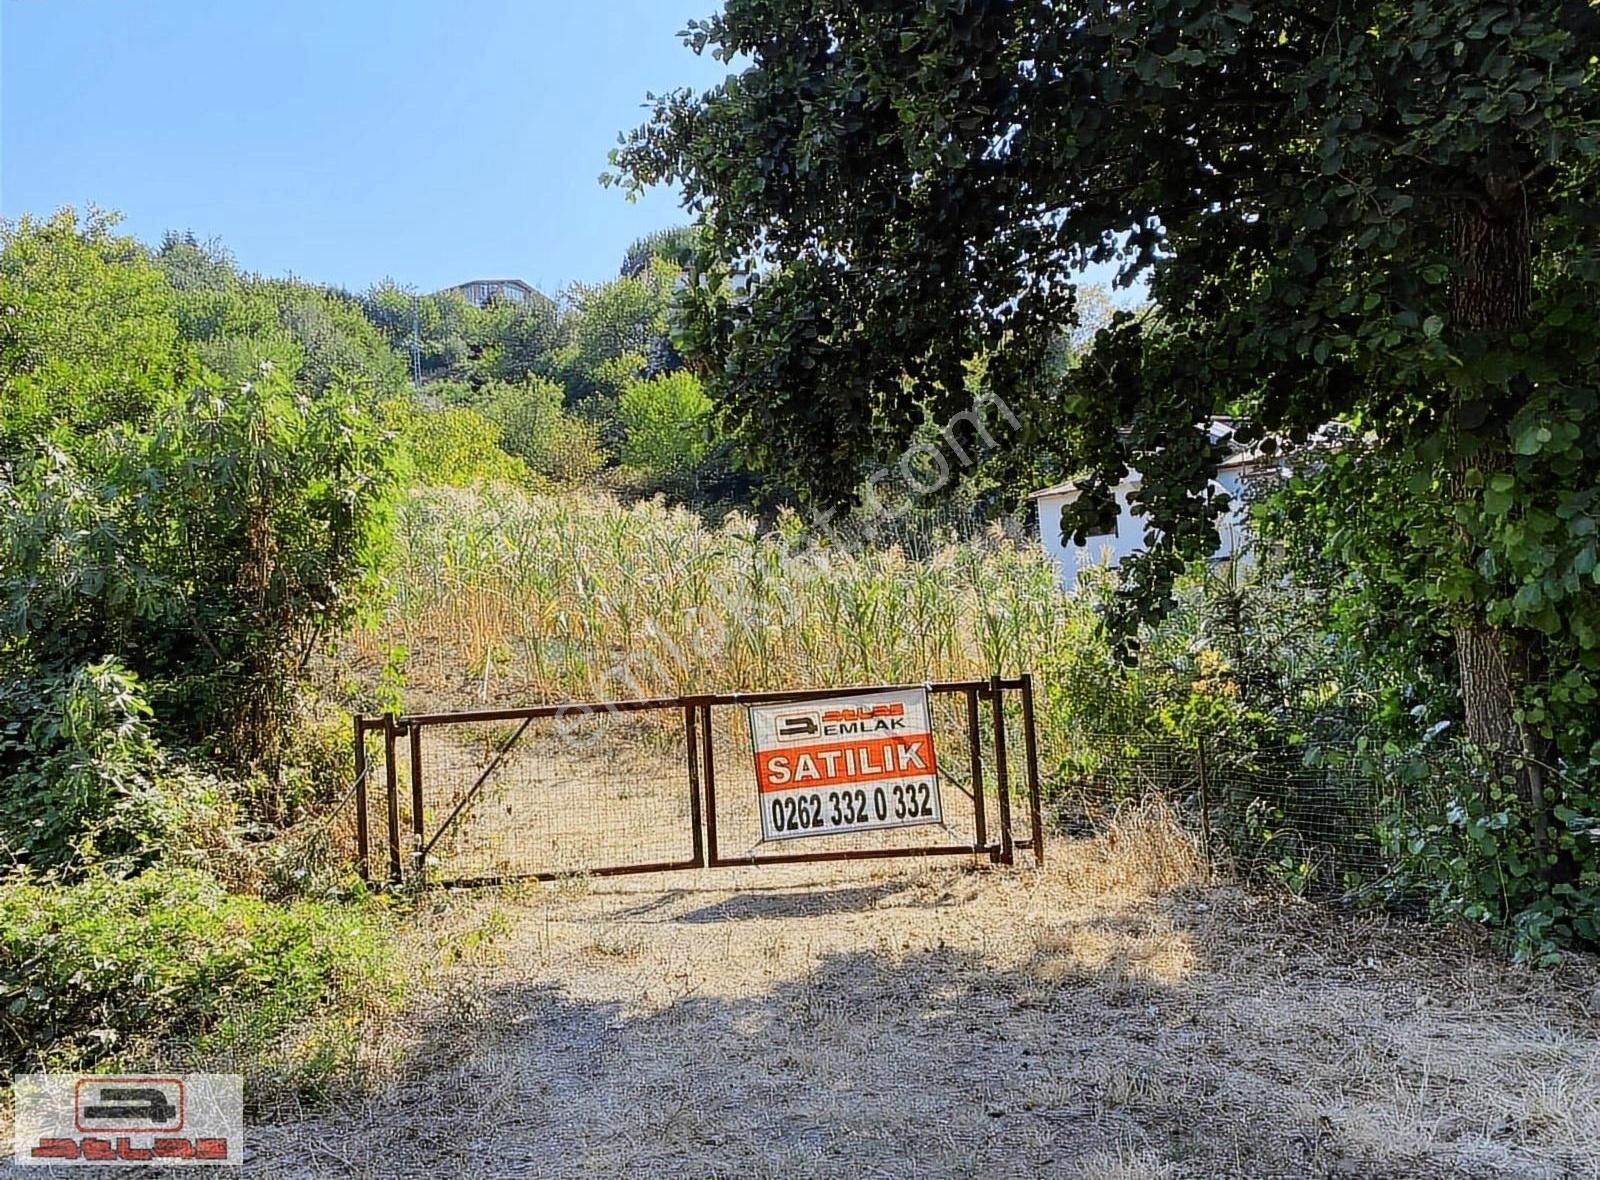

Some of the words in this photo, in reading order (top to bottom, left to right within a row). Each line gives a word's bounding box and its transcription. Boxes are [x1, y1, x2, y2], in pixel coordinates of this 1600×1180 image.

[824, 718, 906, 736] EMLAK
[767, 741, 927, 785] SATILIK
[772, 794, 824, 832] 0262
[829, 789, 869, 826] 332
[874, 787, 887, 821] 0
[893, 783, 933, 819] 332
